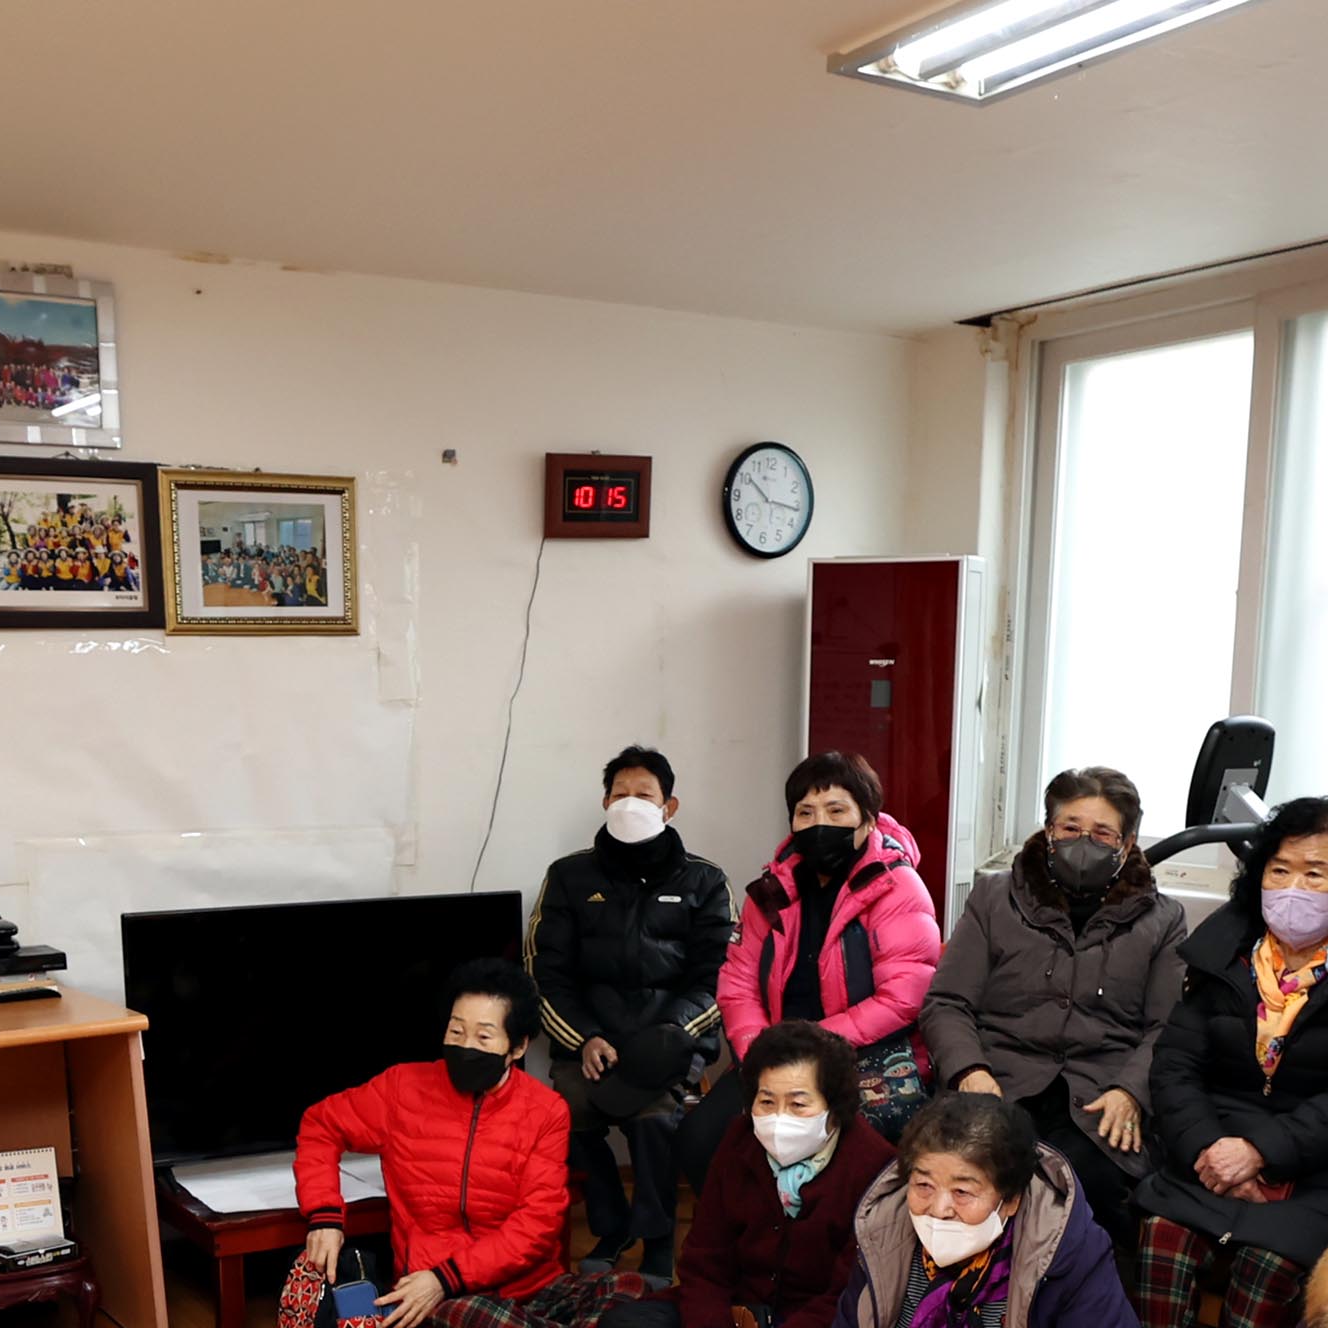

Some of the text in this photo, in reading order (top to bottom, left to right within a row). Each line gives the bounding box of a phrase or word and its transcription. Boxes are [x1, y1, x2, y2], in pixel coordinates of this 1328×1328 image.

[752, 460, 762, 473] 11
[766, 457, 778, 471] 12
[740, 472, 752, 485] 10
[791, 481, 800, 494] 2
[574, 486, 627, 508] 10 15
[733, 488, 741, 502] 9
[735, 508, 743, 521] 8
[746, 523, 755, 536] 7
[775, 529, 783, 542] 5
[759, 531, 767, 545] 6
